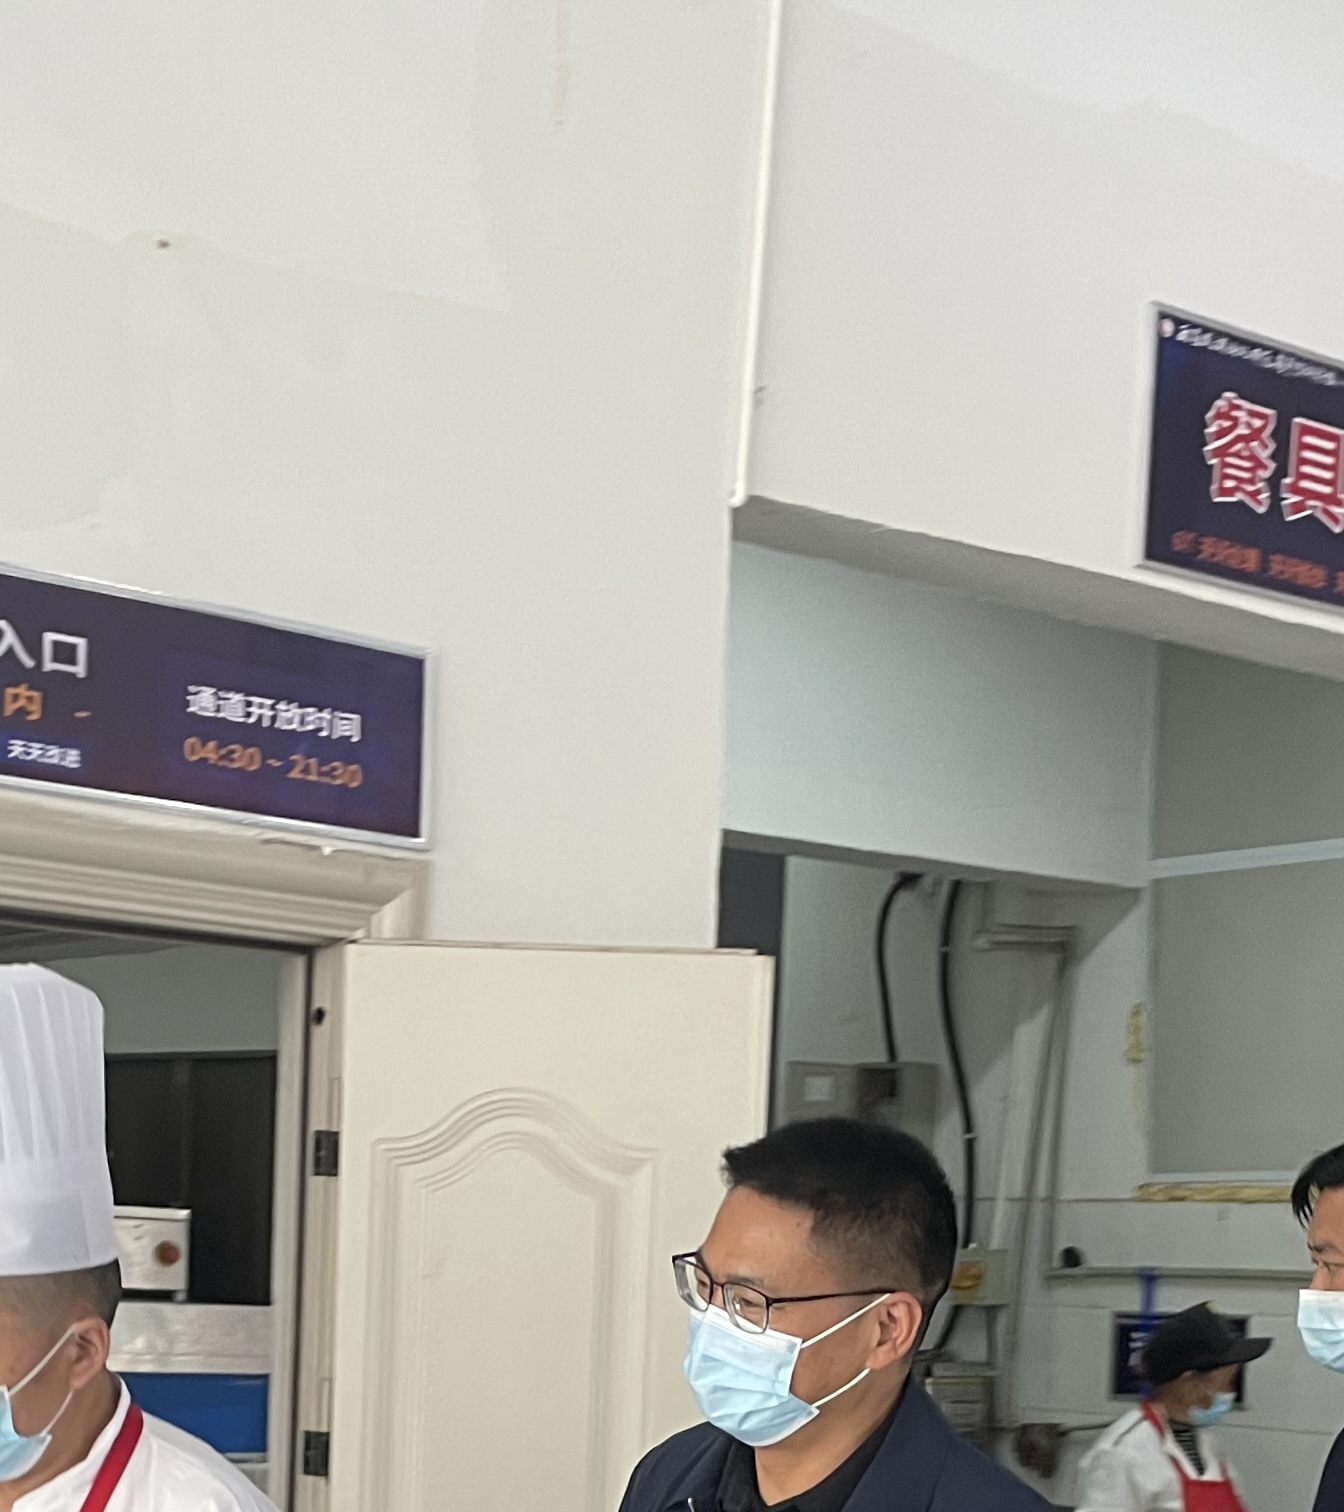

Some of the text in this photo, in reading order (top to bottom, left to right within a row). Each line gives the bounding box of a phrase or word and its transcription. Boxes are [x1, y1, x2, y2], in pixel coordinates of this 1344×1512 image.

[185, 684, 362, 743] 通道开放时间
